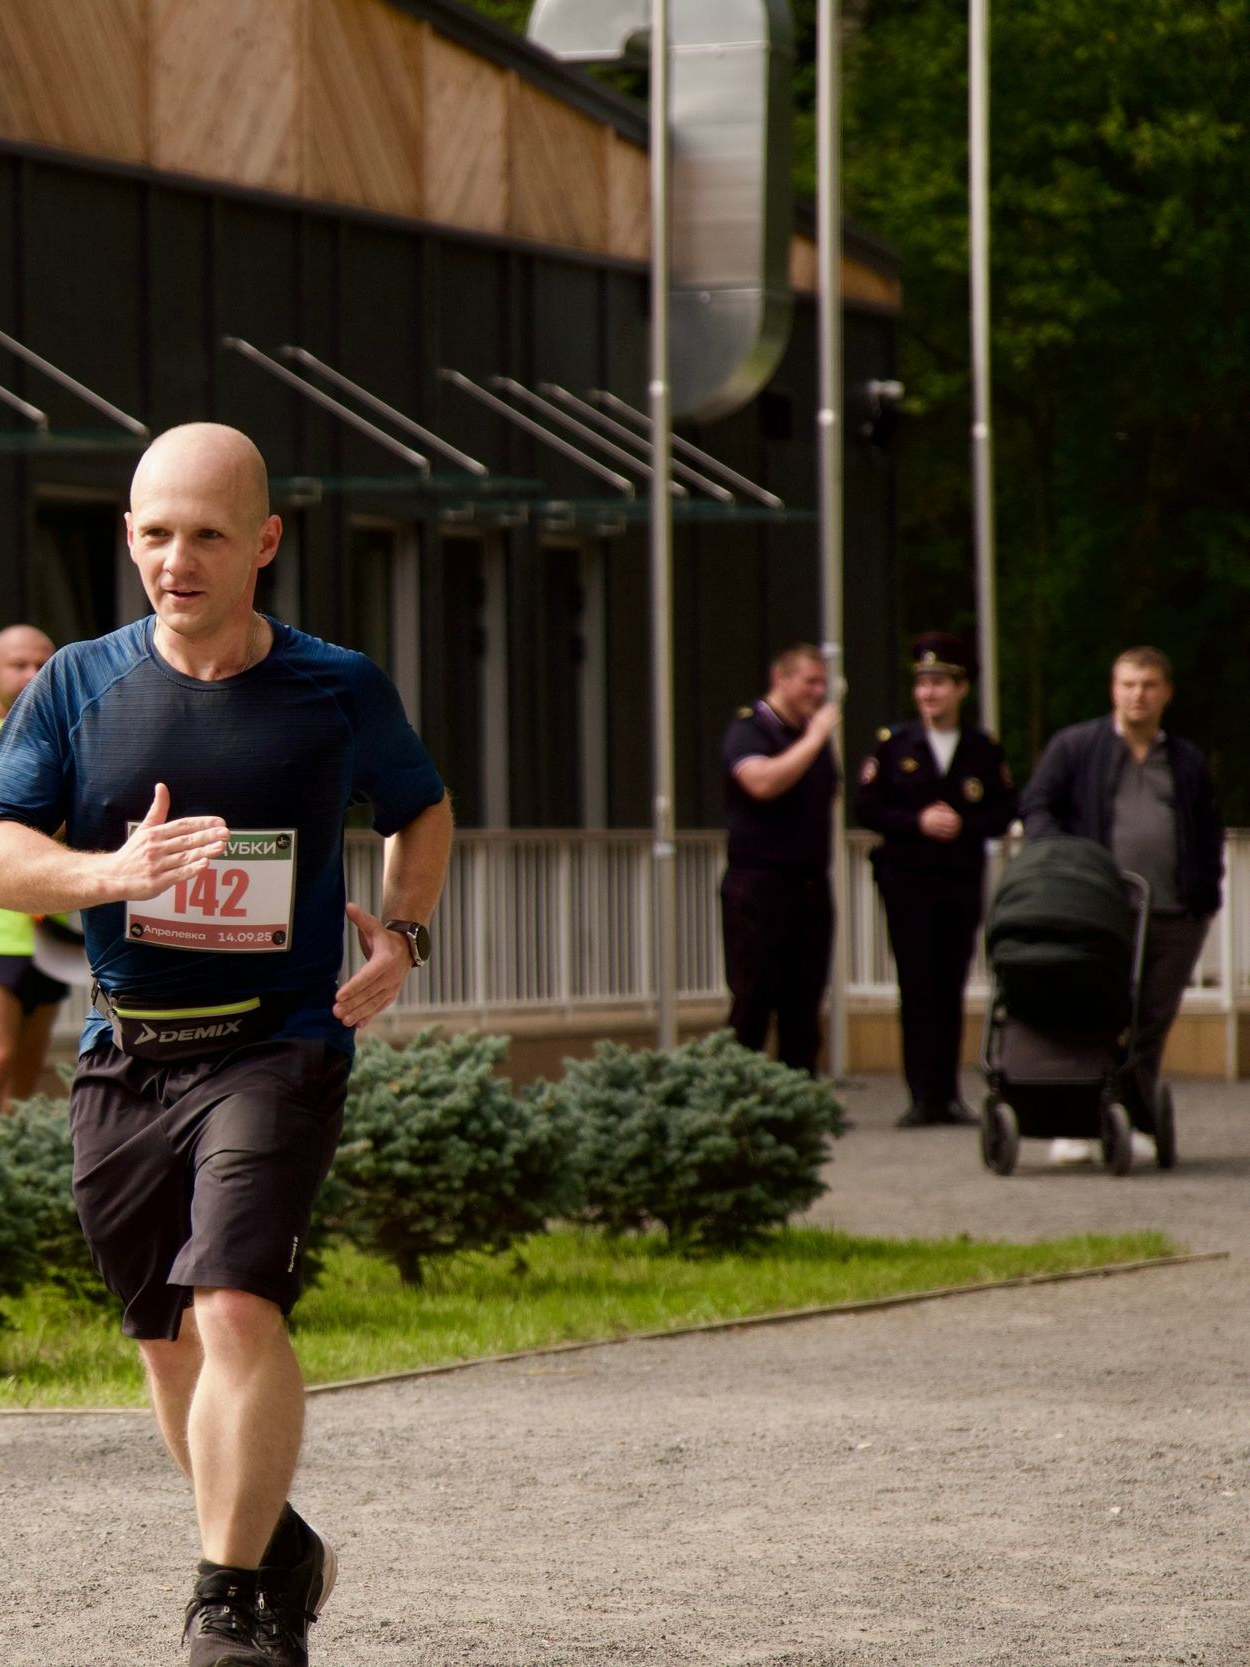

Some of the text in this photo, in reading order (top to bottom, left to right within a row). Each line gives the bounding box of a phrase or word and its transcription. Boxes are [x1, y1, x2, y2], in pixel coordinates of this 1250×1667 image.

[173, 868, 250, 918] 142
[143, 924, 272, 942] Апрелевка 14.09.25
[159, 1019, 243, 1043] DEMIX
